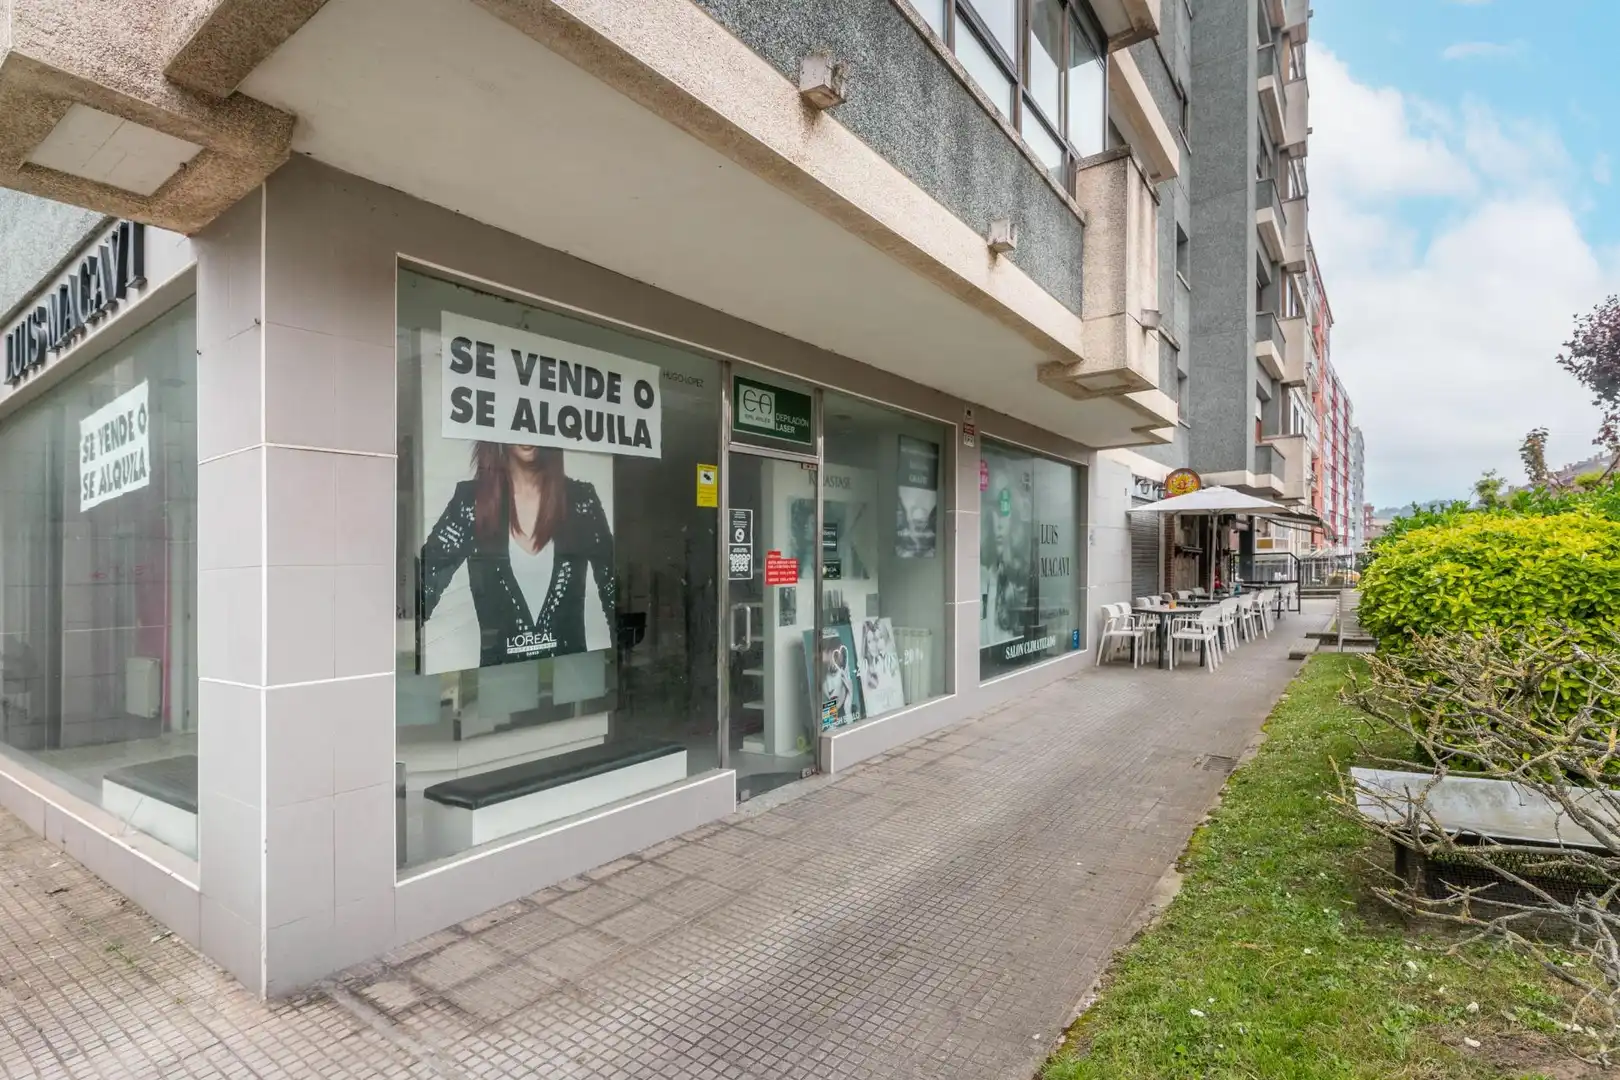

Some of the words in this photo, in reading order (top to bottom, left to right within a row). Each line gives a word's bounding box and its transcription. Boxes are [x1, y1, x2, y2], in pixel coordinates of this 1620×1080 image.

[4, 306, 48, 385] LUIS
[46, 222, 147, 352] MACAVI
[449, 336, 496, 379] SE
[511, 349, 622, 404] VENDE
[633, 379, 655, 410] O
[82, 432, 96, 464] SE
[98, 409, 135, 456] VENDE
[137, 402, 147, 435] O
[450, 386, 496, 427] SE
[510, 397, 653, 450] ALQUILA
[775, 422, 796, 434] LASER
[82, 470, 96, 501] SE
[98, 446, 147, 496] ALQUILA
[1040, 523, 1059, 545] LUIS
[1040, 557, 1070, 578] MACAVI
